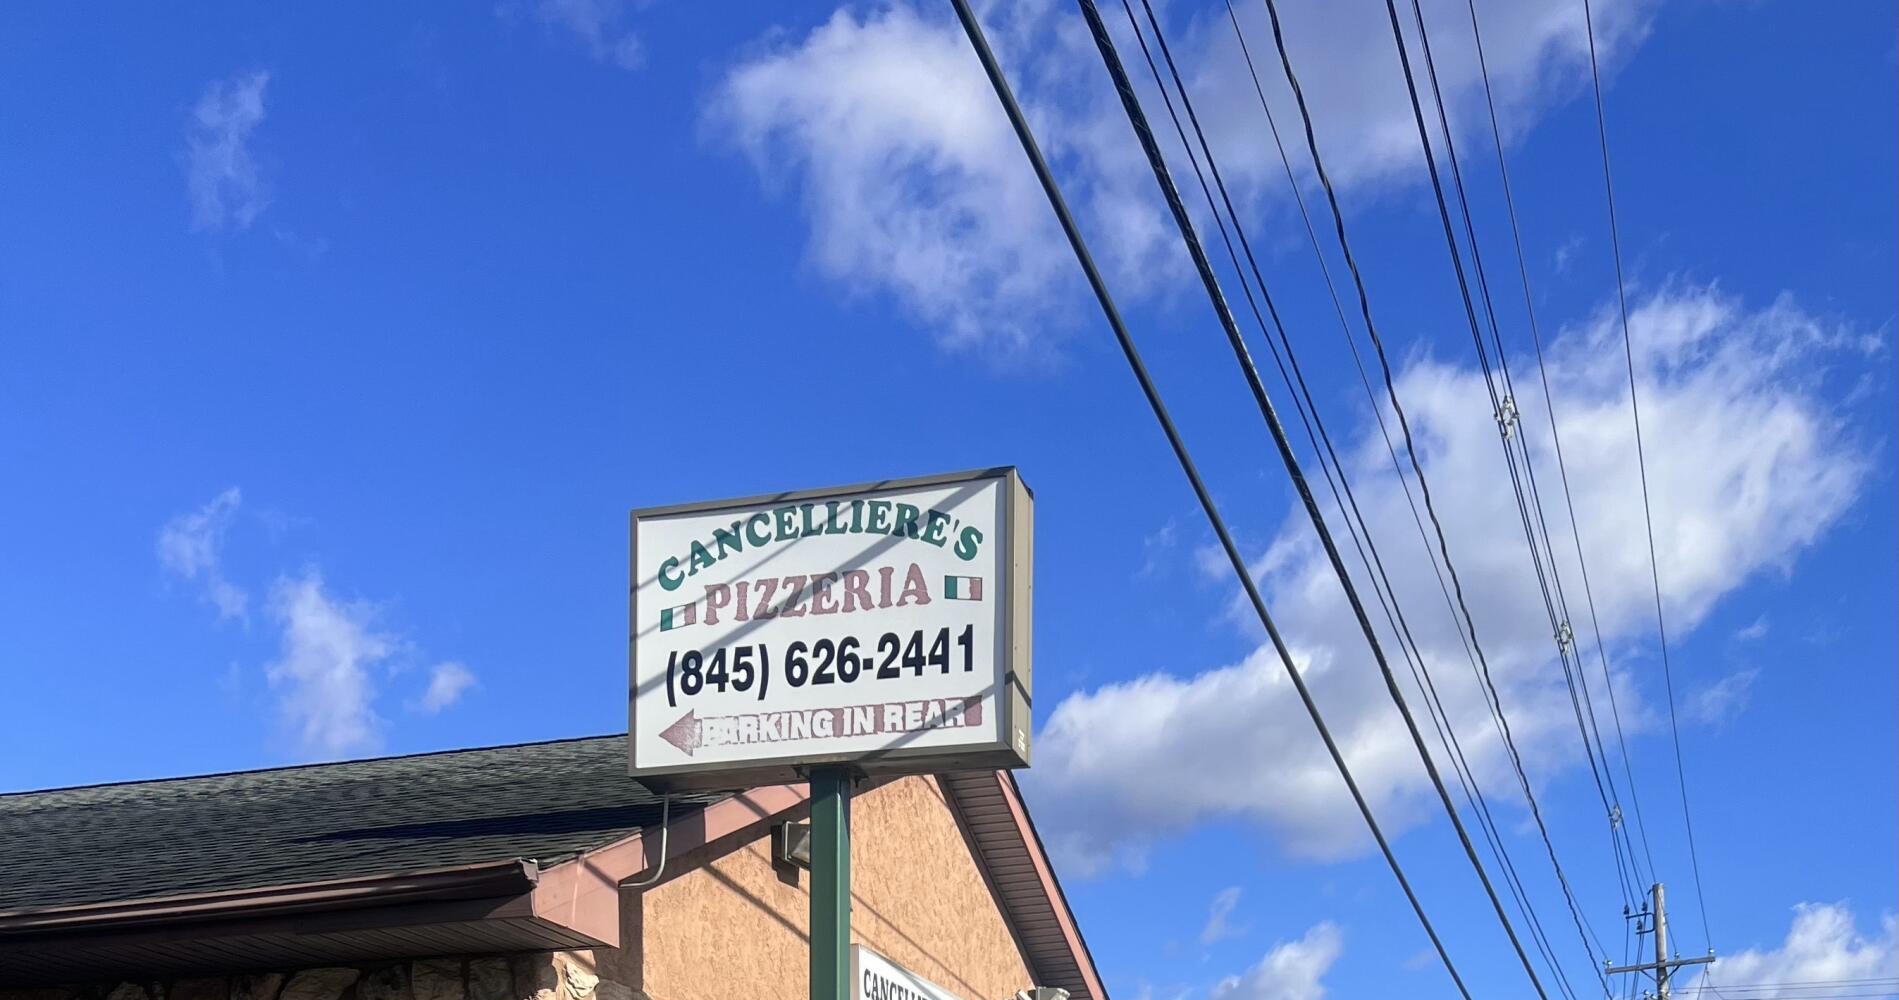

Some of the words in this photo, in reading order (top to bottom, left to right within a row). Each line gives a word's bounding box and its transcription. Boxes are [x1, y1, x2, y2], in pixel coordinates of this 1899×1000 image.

[657, 500, 984, 592] CANCELLIERE'S
[703, 562, 932, 626] PIZZERIA
[666, 643, 769, 707] (845)
[784, 623, 974, 688] 626-2441
[702, 707, 834, 744] PARKING
[841, 703, 874, 736] IN
[884, 699, 966, 733] REAR
